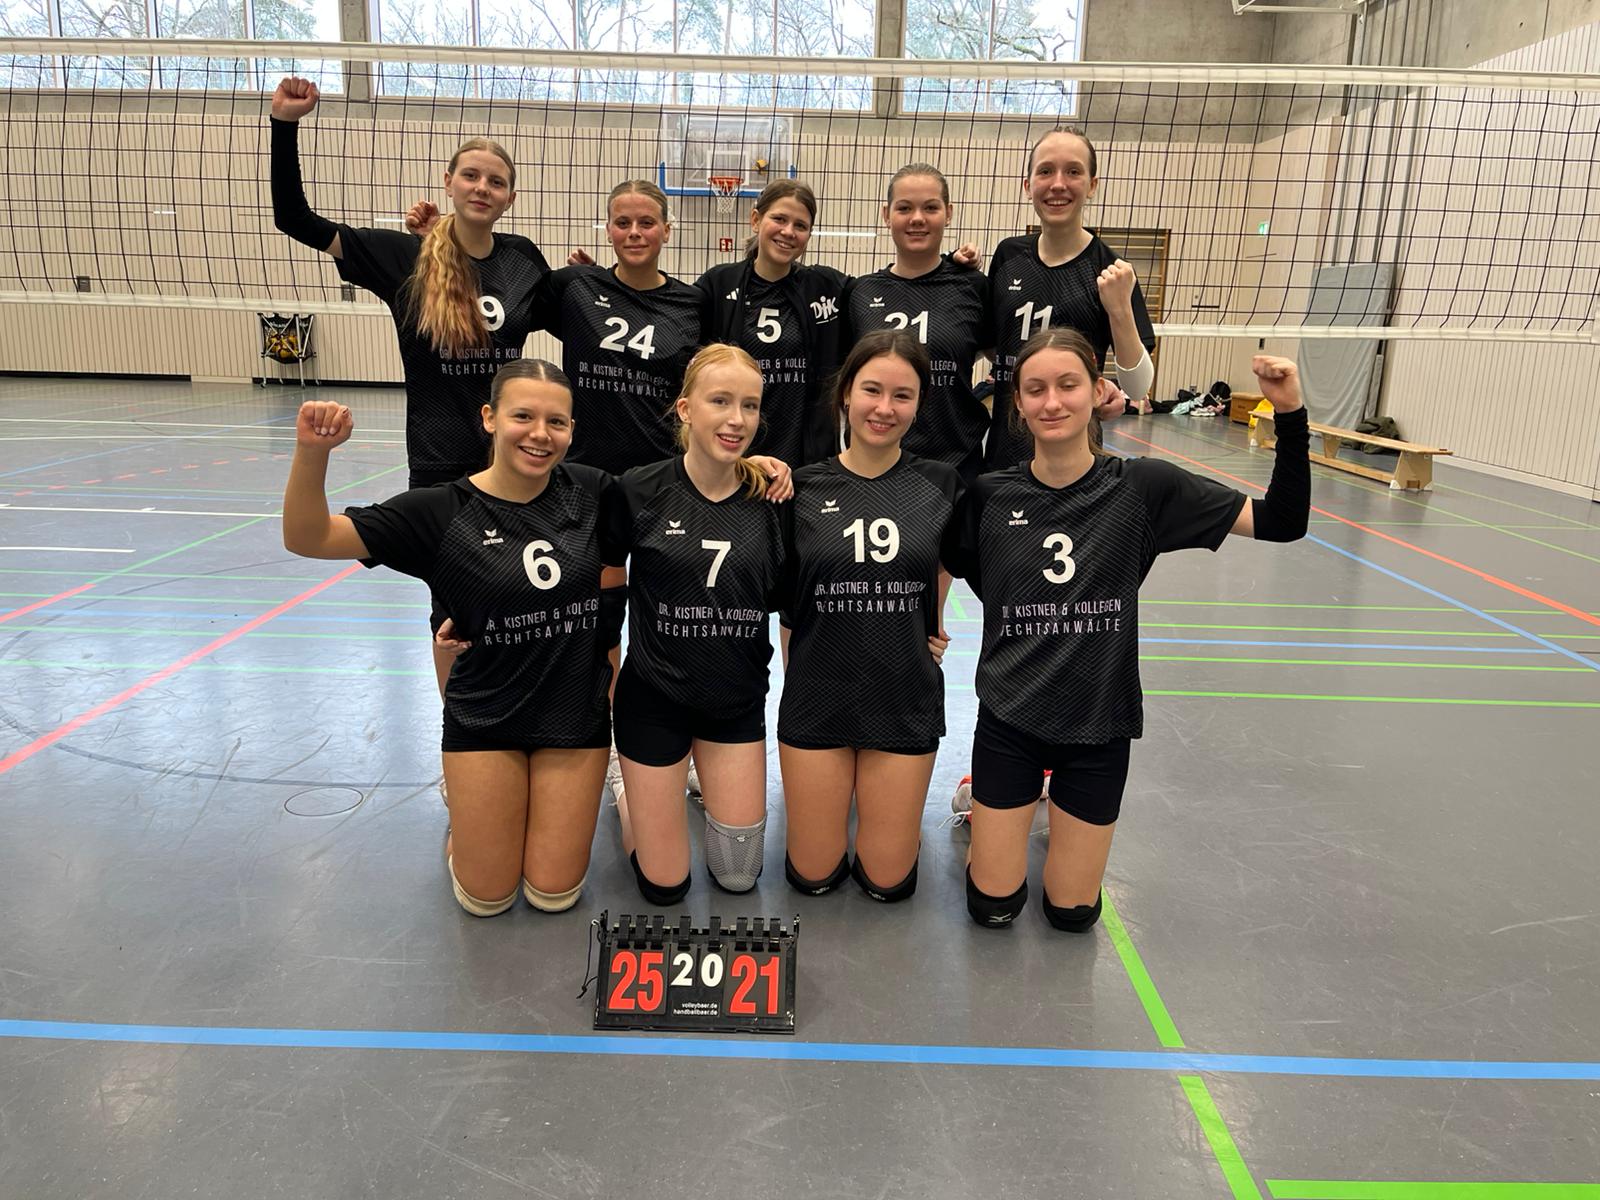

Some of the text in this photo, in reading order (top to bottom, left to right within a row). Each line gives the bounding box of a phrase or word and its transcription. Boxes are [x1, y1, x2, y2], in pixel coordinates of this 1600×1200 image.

[477, 295, 505, 331] 9
[756, 307, 782, 344] 5
[884, 311, 929, 344] 21
[1014, 301, 1053, 341] 11
[495, 347, 501, 359] &
[599, 316, 656, 360] 24
[593, 363, 623, 378] KISTNER
[627, 368, 633, 379] &
[843, 518, 900, 563] 19
[1042, 532, 1076, 584] 3
[522, 539, 562, 590] 6
[701, 539, 732, 587] 7
[830, 581, 869, 595] KISTNER
[875, 581, 881, 594] &
[504, 610, 547, 629] KISTNER
[553, 608, 560, 620] &
[674, 606, 713, 620] KISTNER
[1015, 603, 1057, 618] KISTNER
[1062, 603, 1068, 616] &
[608, 951, 664, 1012] 25
[730, 955, 780, 1014] 21
